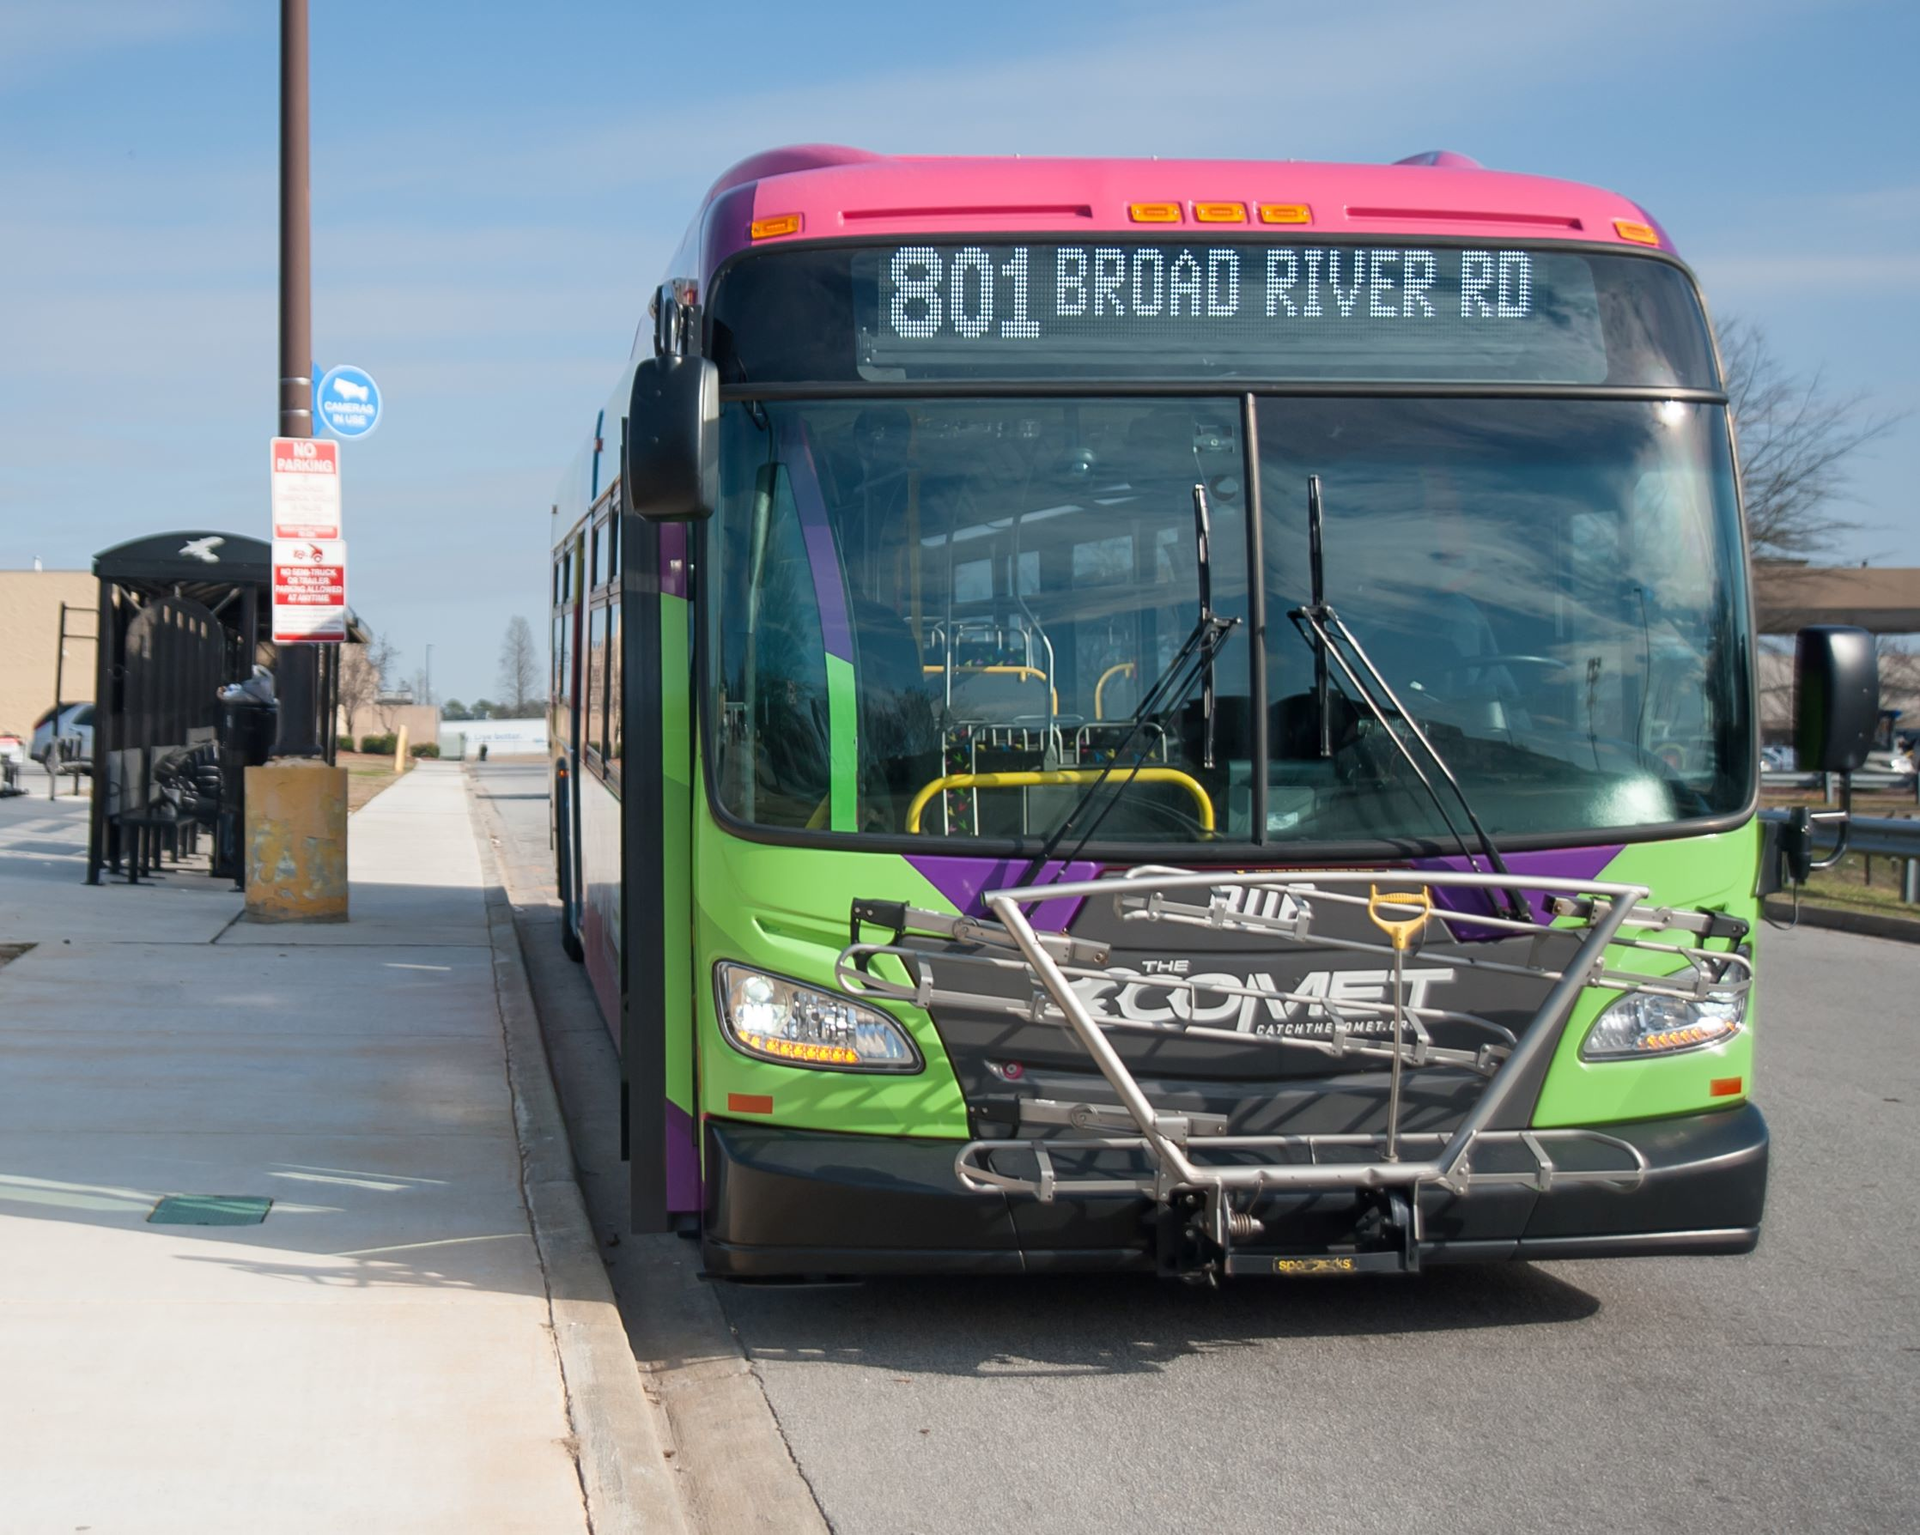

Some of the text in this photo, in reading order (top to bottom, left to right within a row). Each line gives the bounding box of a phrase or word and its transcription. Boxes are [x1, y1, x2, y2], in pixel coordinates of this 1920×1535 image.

[891, 247, 1533, 338] 801 BROAD RIVER RD
[324, 401, 375, 416] CAMERAS
[333, 413, 367, 427] IN USE
[292, 441, 317, 458] NO
[276, 457, 334, 472] PARKING
[280, 567, 291, 577] NO
[299, 577, 330, 585] TRAILER
[275, 585, 343, 594] PARKING ALLOWED
[288, 594, 297, 603] AT
[1142, 960, 1189, 972] THE
[1256, 1019, 1415, 1035] CATCHTHEOMET.OR
